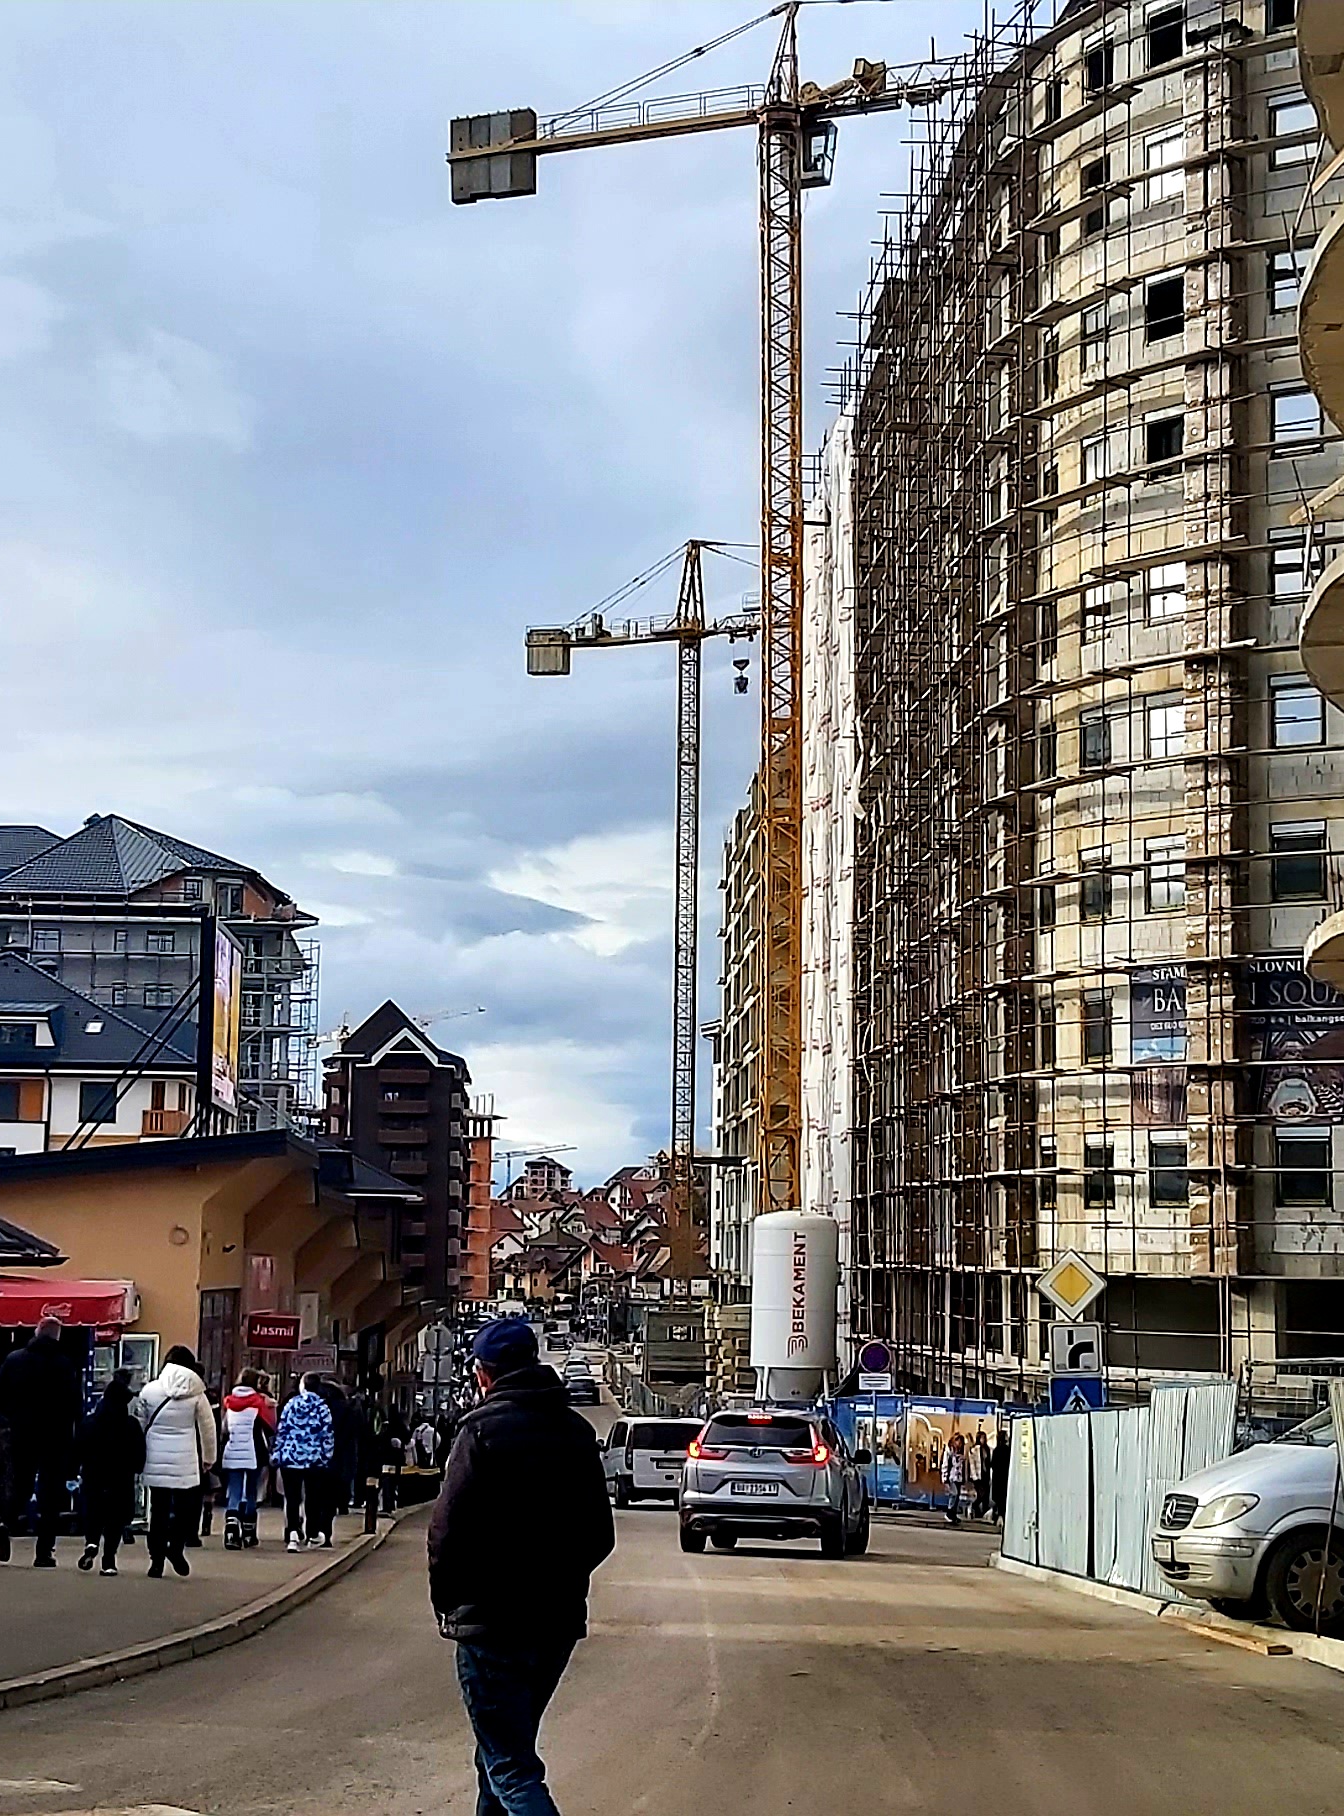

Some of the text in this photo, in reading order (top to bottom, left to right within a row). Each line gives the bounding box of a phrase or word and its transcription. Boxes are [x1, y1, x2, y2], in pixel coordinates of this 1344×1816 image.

[1154, 987, 1187, 1012] BA
[792, 1231, 806, 1333] BEKAMENT
[252, 1323, 295, 1337] Jasmil
